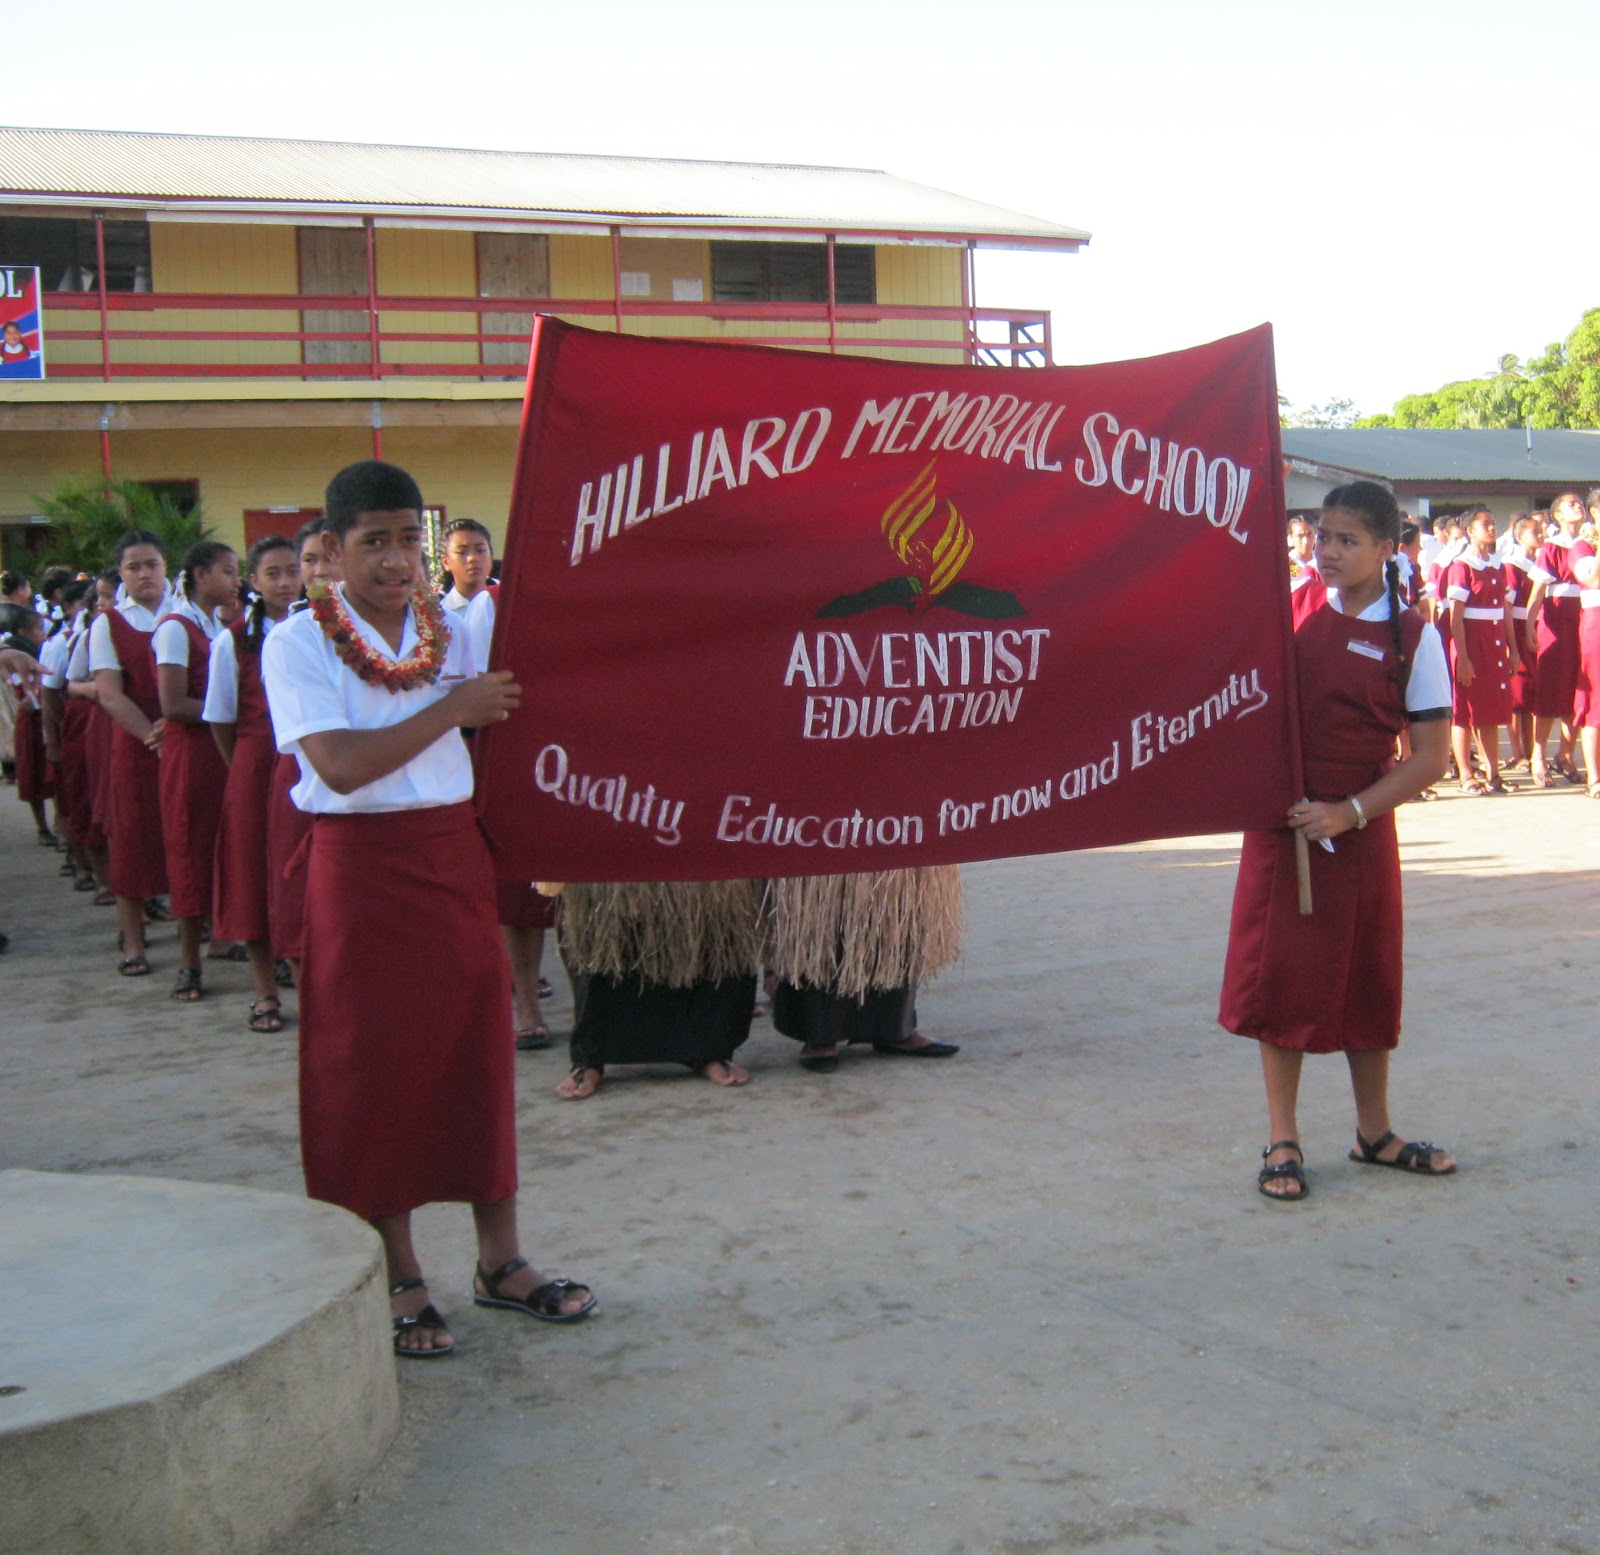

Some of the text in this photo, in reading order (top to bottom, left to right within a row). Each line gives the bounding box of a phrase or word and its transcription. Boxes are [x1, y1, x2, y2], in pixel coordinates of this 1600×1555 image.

[570, 391, 1250, 567] HILLIARD MEMORIAL SCHOOL
[784, 629, 1050, 688] ADVENTIST
[803, 687, 1024, 739] EDUCATION
[535, 669, 1268, 849] Quality Education for now and Eternity
